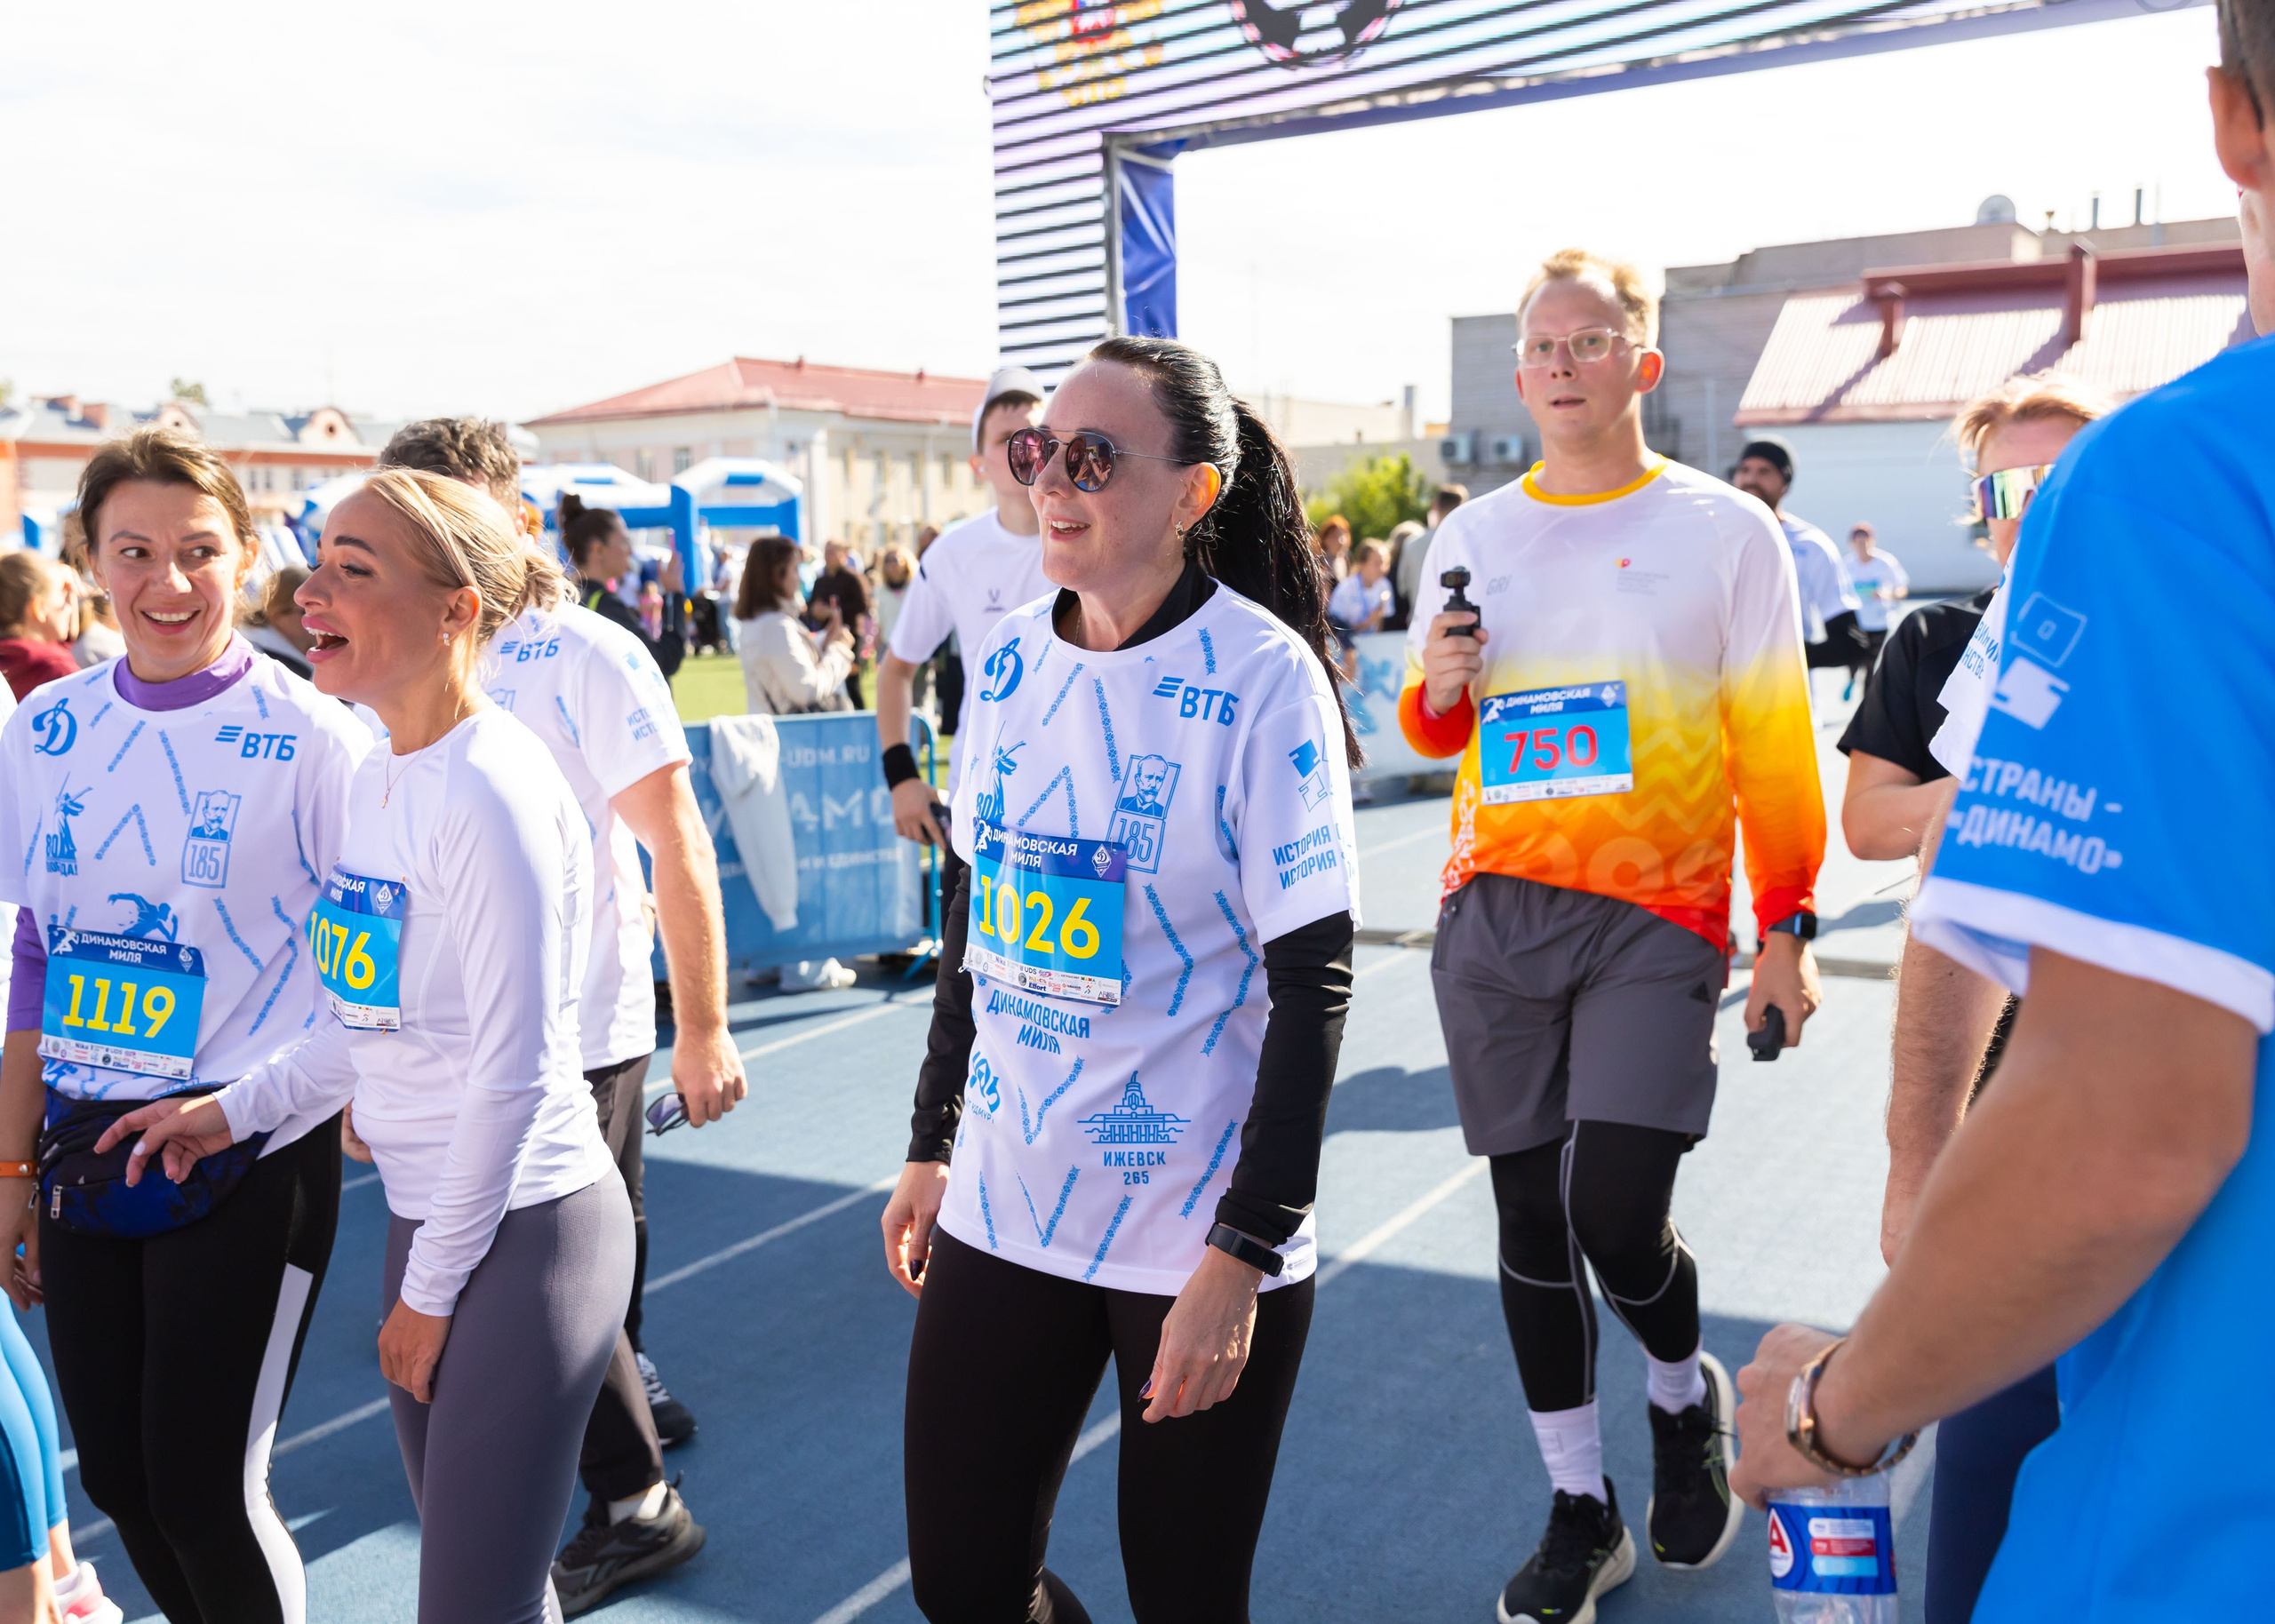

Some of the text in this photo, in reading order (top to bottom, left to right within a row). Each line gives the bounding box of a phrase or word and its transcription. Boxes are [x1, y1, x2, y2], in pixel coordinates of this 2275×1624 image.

[1180, 689, 1240, 727] ВТБ
[1505, 688, 1591, 709] ДИНАМОВСКАЯ
[1529, 701, 1564, 714] МИЛЯ
[241, 733, 297, 761] ВТБ
[1504, 724, 1598, 774] 750
[1960, 755, 2098, 822] СТРАНЫ
[976, 792, 993, 820] 80
[45, 833, 60, 858] 80
[993, 829, 1078, 856] ДИНАМОВСКАЯ
[1118, 818, 1153, 863] 185
[1273, 825, 1331, 866] ИСТОРИЯ
[188, 843, 221, 880] 185
[1010, 849, 1042, 868] МИЛЯ
[1280, 849, 1337, 890] ИСТОРИЯ
[979, 874, 1100, 959] 1026
[81, 933, 167, 954] ДИНАМОВСКАЯ
[108, 950, 142, 963] МИЛЯ
[310, 911, 375, 990] 1076
[1024, 966, 1037, 975] UDS
[1028, 982, 1047, 991] Effort
[62, 974, 176, 1039] 1119
[986, 990, 1090, 1039] ДИНАМОВСКАЯ
[1017, 1023, 1062, 1055] МИЛЯ
[1103, 1150, 1166, 1167] ИЖЕВСК
[1123, 1171, 1150, 1185] 265
